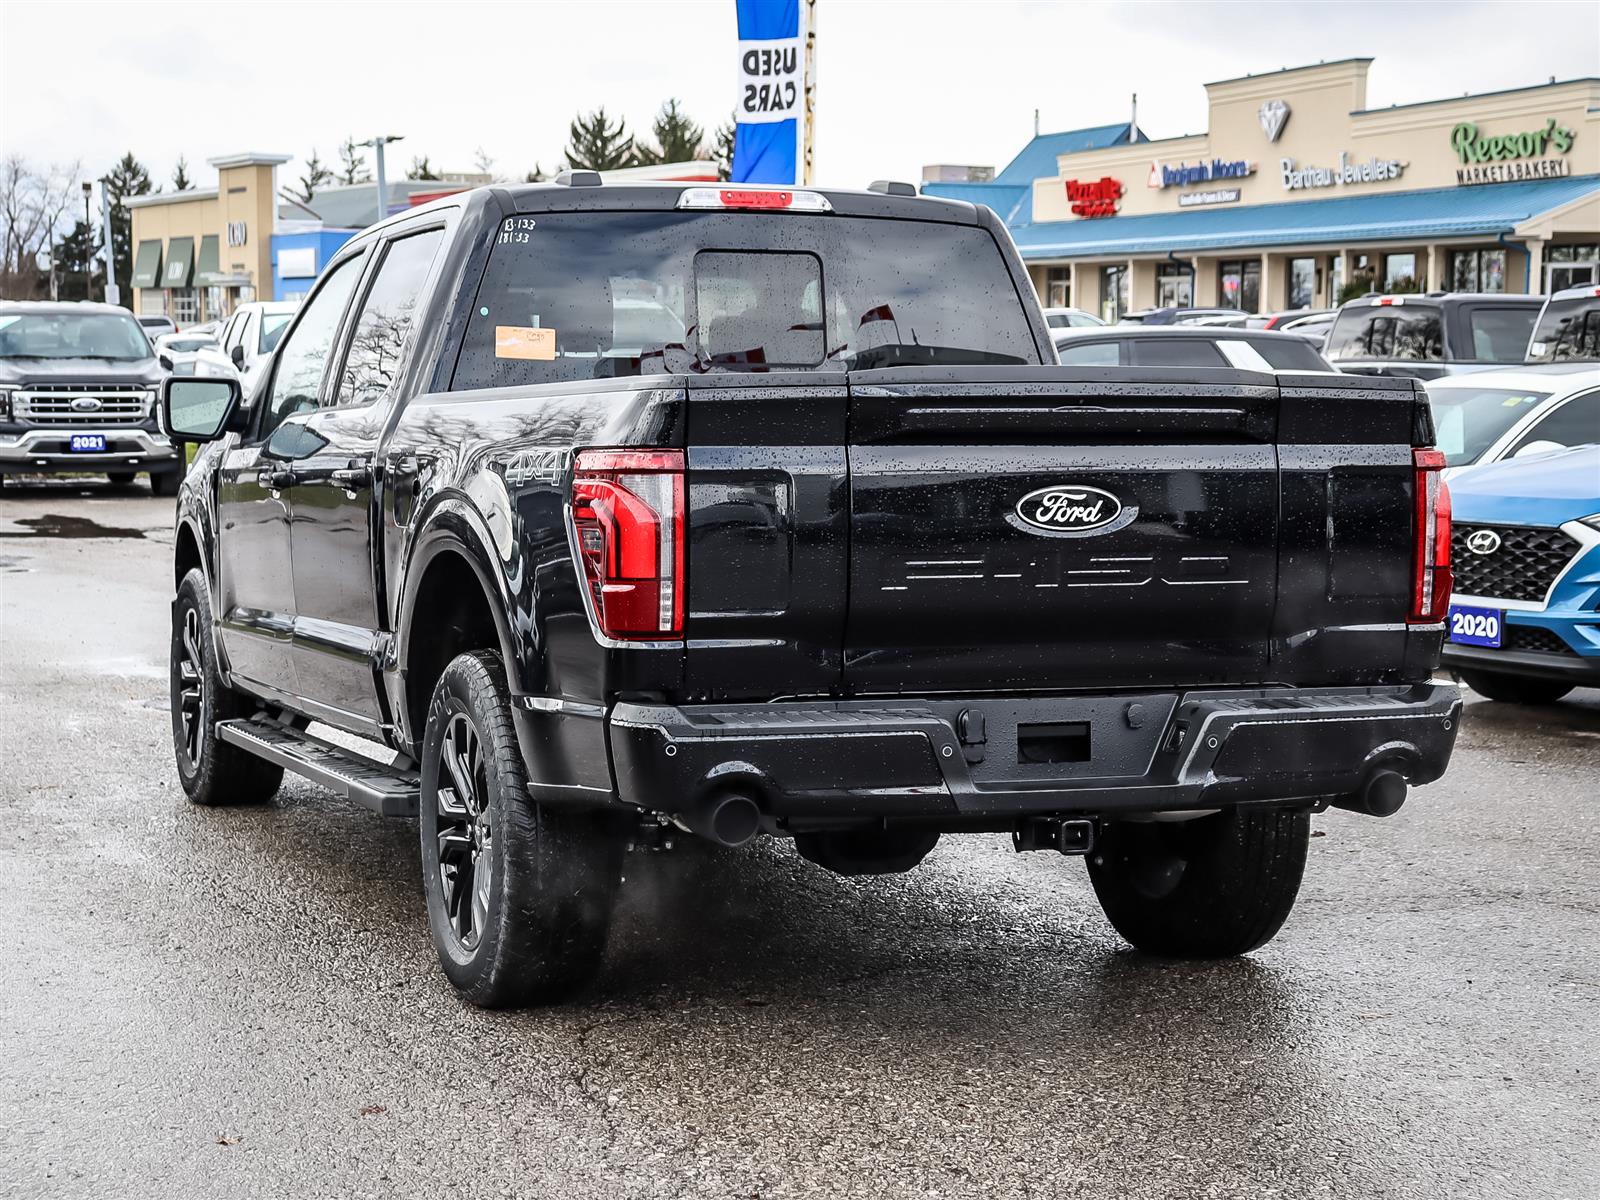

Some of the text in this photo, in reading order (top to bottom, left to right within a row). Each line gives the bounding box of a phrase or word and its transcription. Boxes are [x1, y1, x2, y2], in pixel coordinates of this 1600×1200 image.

[1450, 117, 1574, 165] Reesor's
[1334, 150, 1400, 185] Jewellers
[72, 436, 103, 449] 2021
[1036, 491, 1103, 523] Ford
[1452, 612, 1499, 639] 2020
